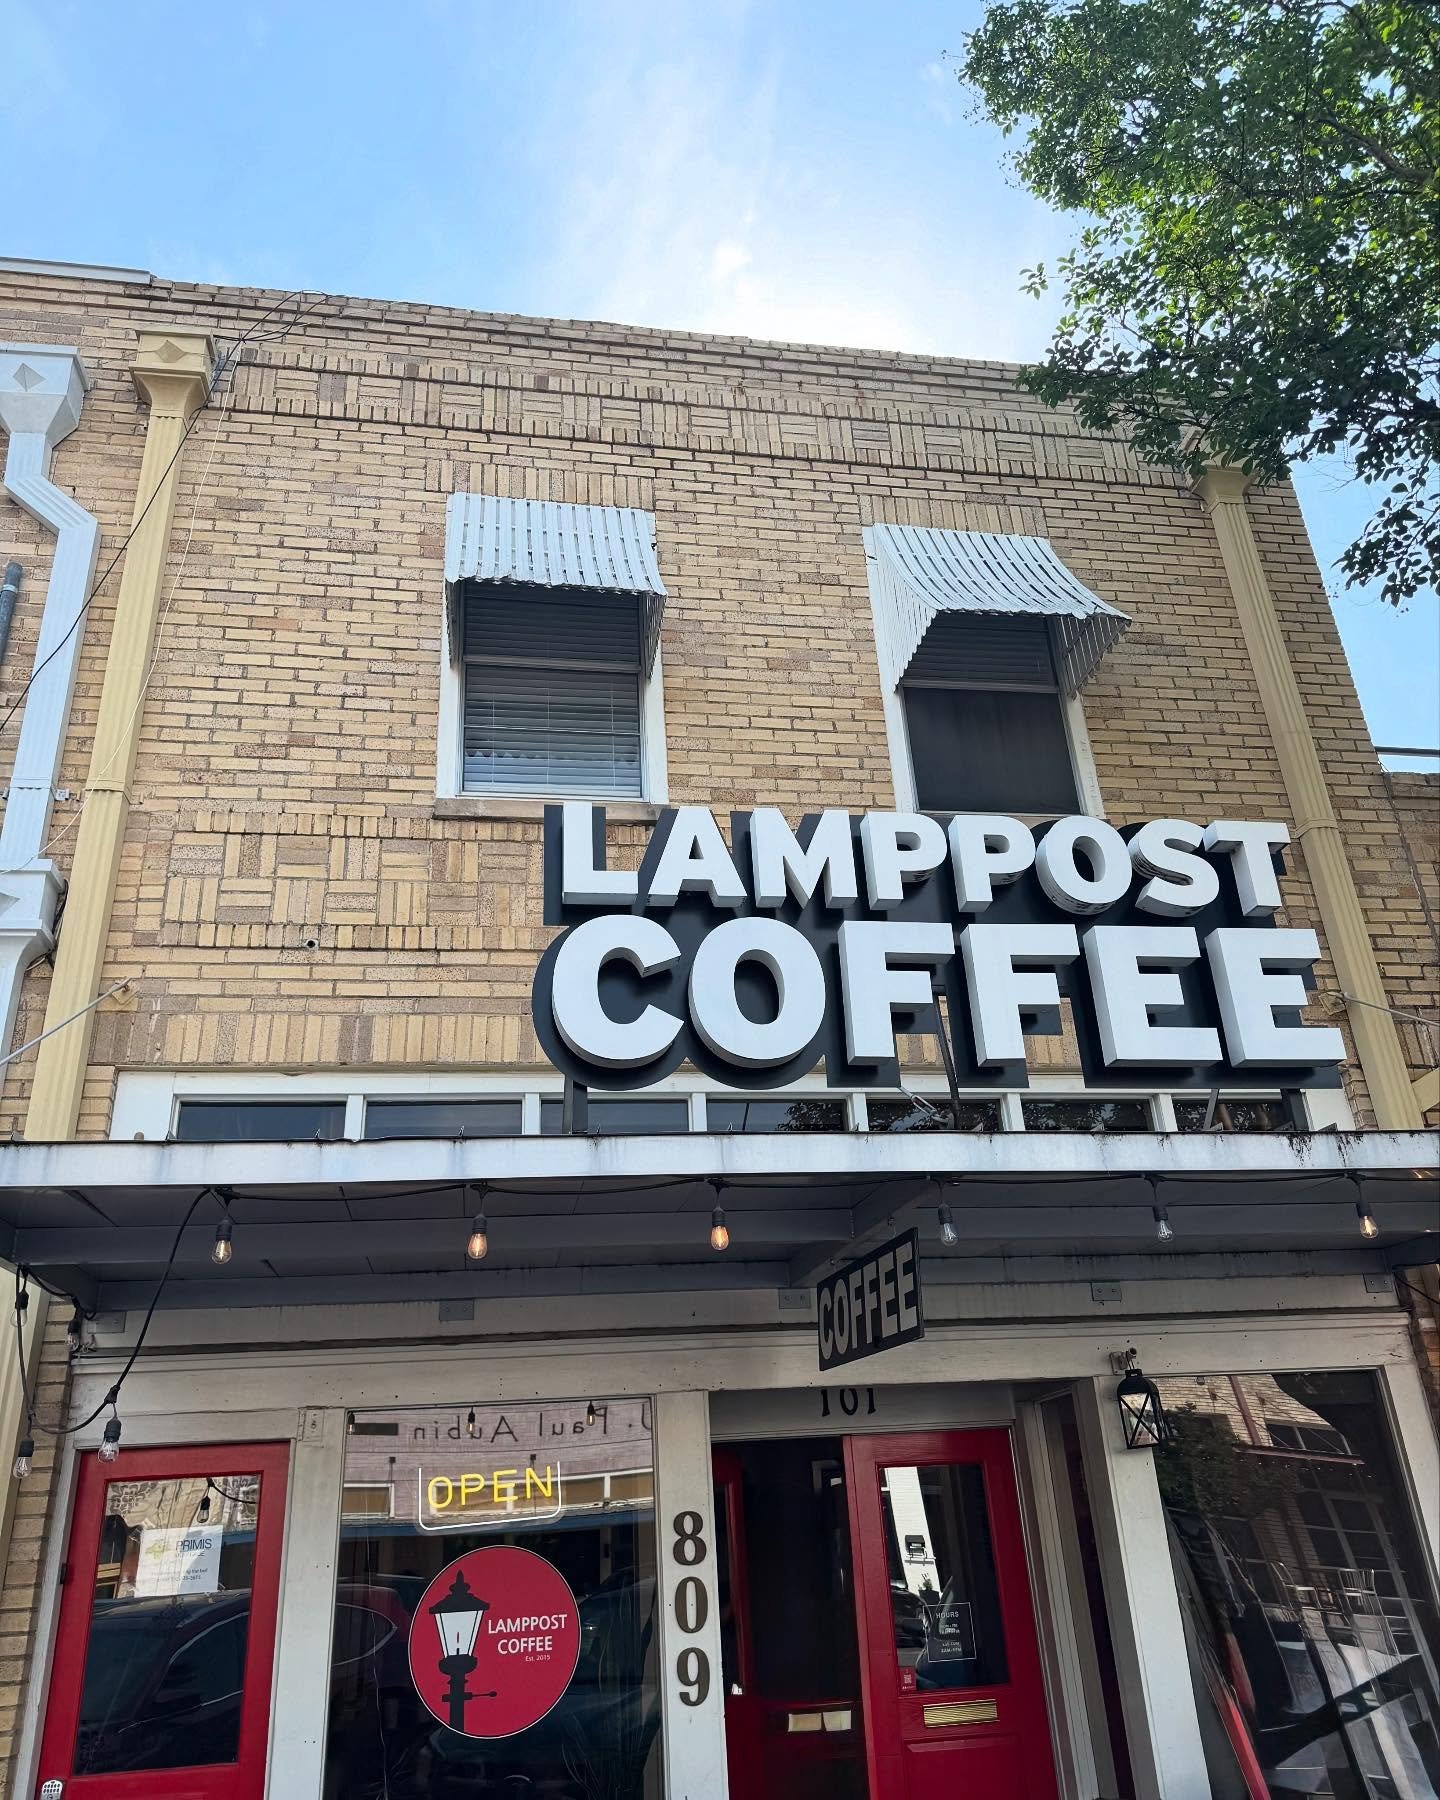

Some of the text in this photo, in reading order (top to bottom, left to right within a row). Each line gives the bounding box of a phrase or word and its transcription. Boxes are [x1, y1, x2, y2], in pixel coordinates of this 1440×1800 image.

[562, 801, 1291, 918] LAMPPOST
[552, 914, 1347, 1069] COFFEE
[820, 1241, 918, 1360] COFFEE
[821, 1387, 876, 1417] 101
[427, 1465, 552, 1509] OPEN
[175, 1538, 213, 1553] PRIMIS
[488, 1614, 567, 1634] LAMPPOST
[672, 1510, 711, 1707] 809
[935, 1611, 960, 1619] HOURS
[497, 1636, 553, 1654] COFFEE
